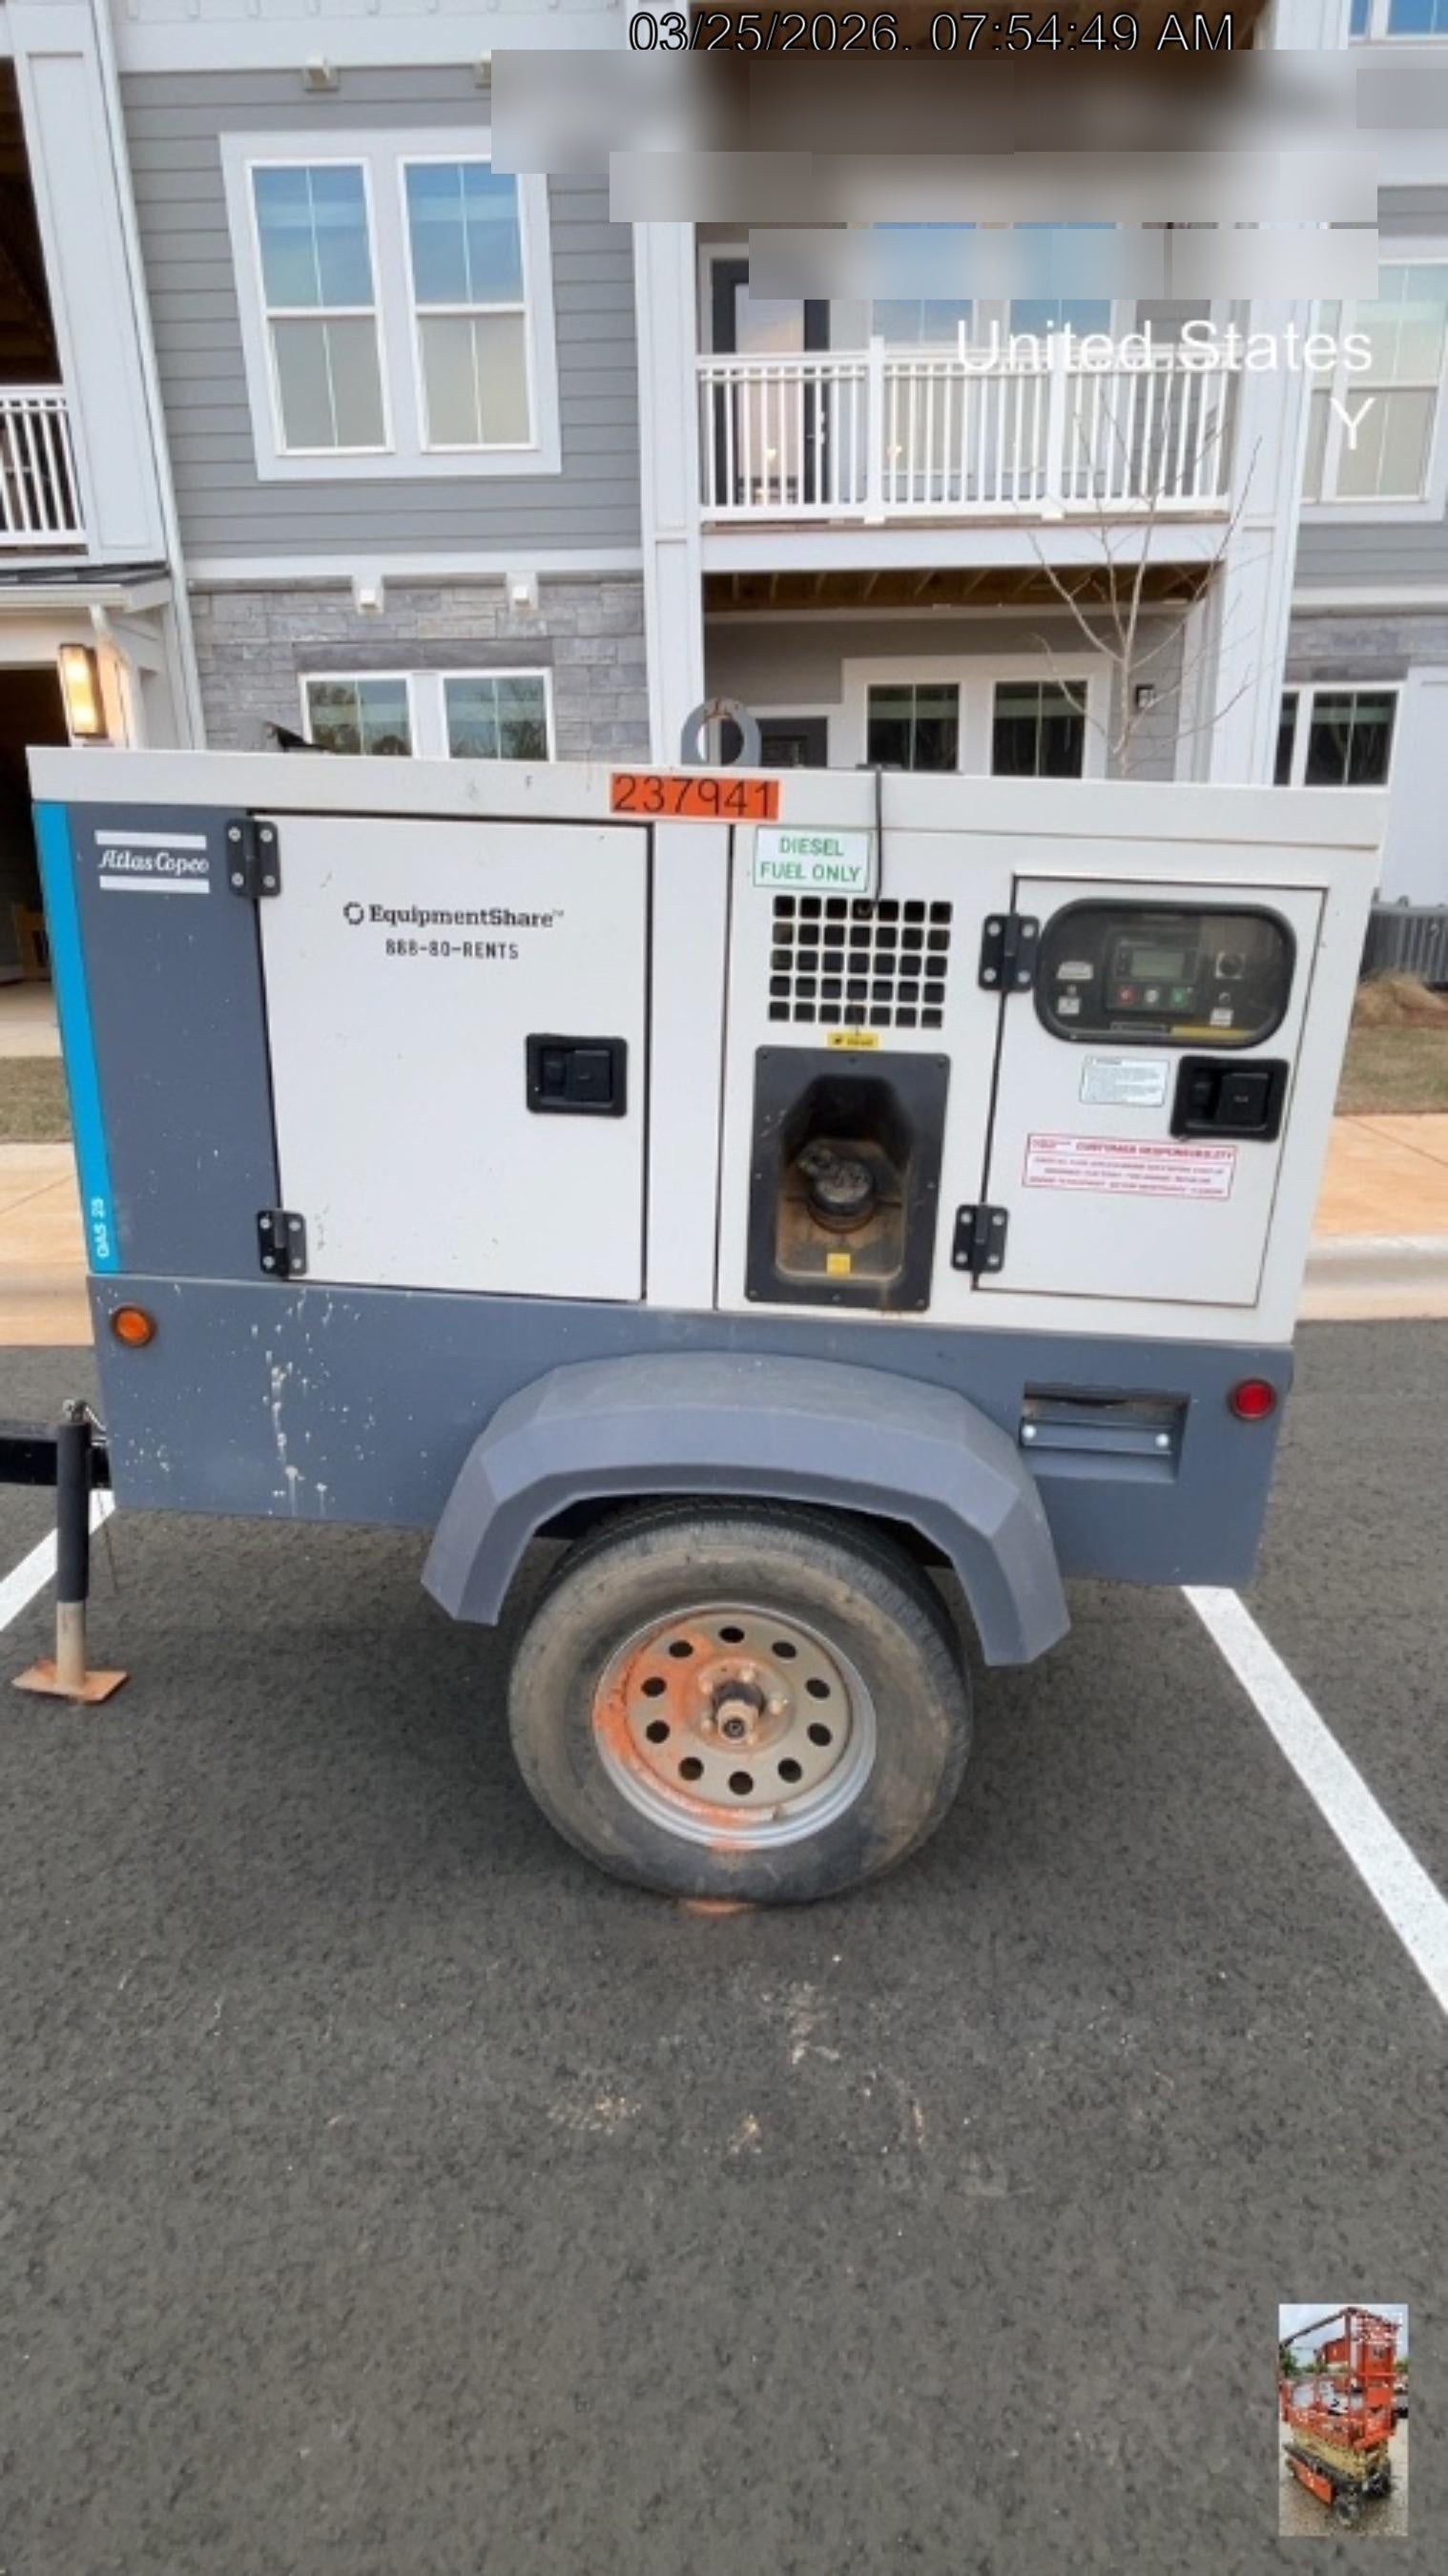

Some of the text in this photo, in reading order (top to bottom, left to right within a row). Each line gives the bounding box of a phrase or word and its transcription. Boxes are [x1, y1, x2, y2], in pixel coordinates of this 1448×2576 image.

[613, 774, 771, 817] 237941
[779, 837, 845, 857] DIESEL
[98, 849, 209, 877] Atlas Copco
[760, 861, 862, 883] FUEL ONLY
[384, 938, 520, 960] 888-80-RENTS
